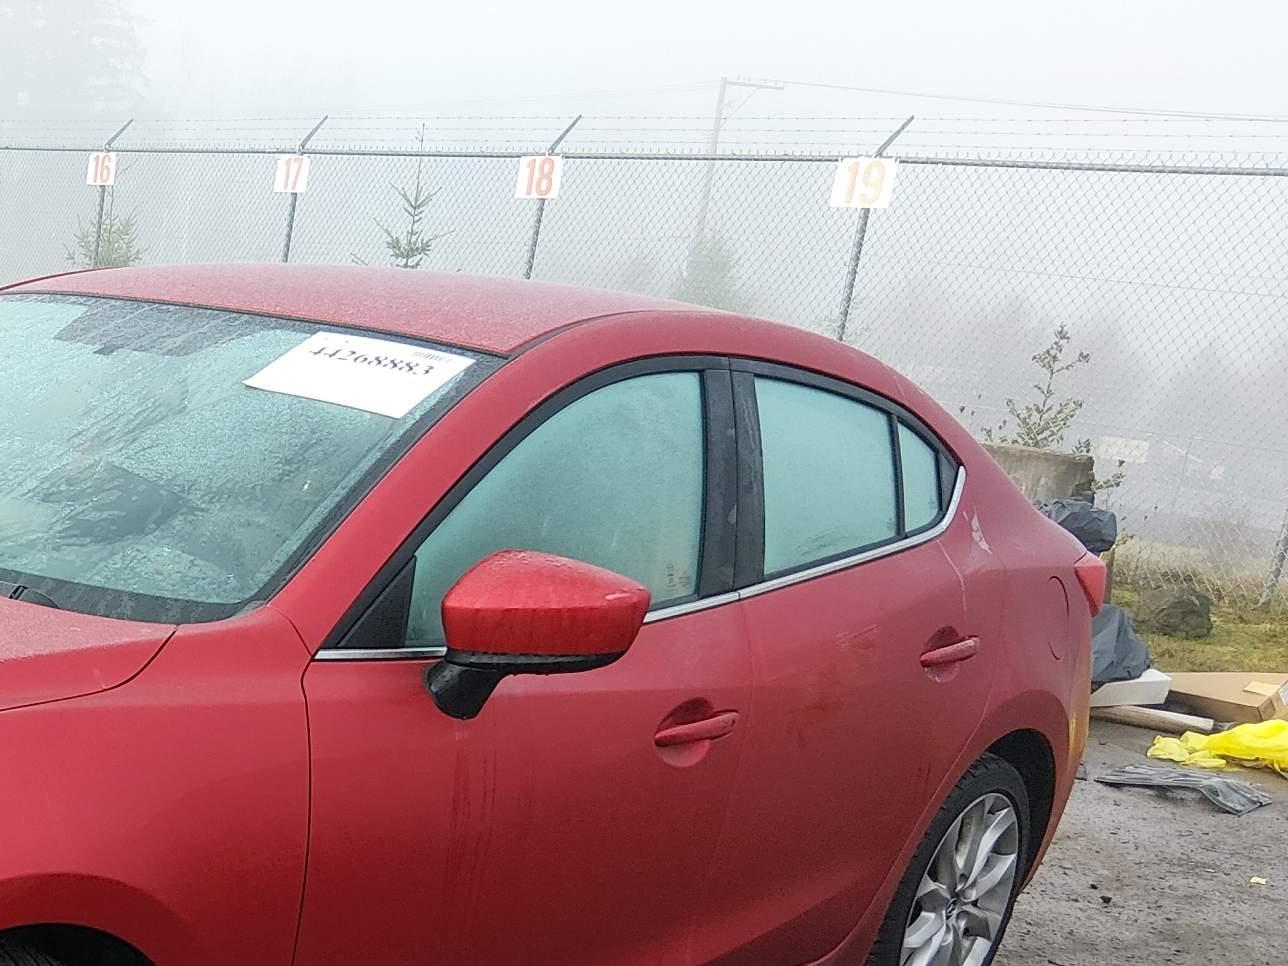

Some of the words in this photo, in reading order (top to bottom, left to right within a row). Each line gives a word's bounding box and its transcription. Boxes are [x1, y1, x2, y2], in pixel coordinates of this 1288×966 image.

[93, 154, 111, 183] 16
[283, 156, 302, 190] 17
[525, 158, 554, 196] 18
[845, 160, 885, 207] 19
[308, 346, 435, 376] 44268883
